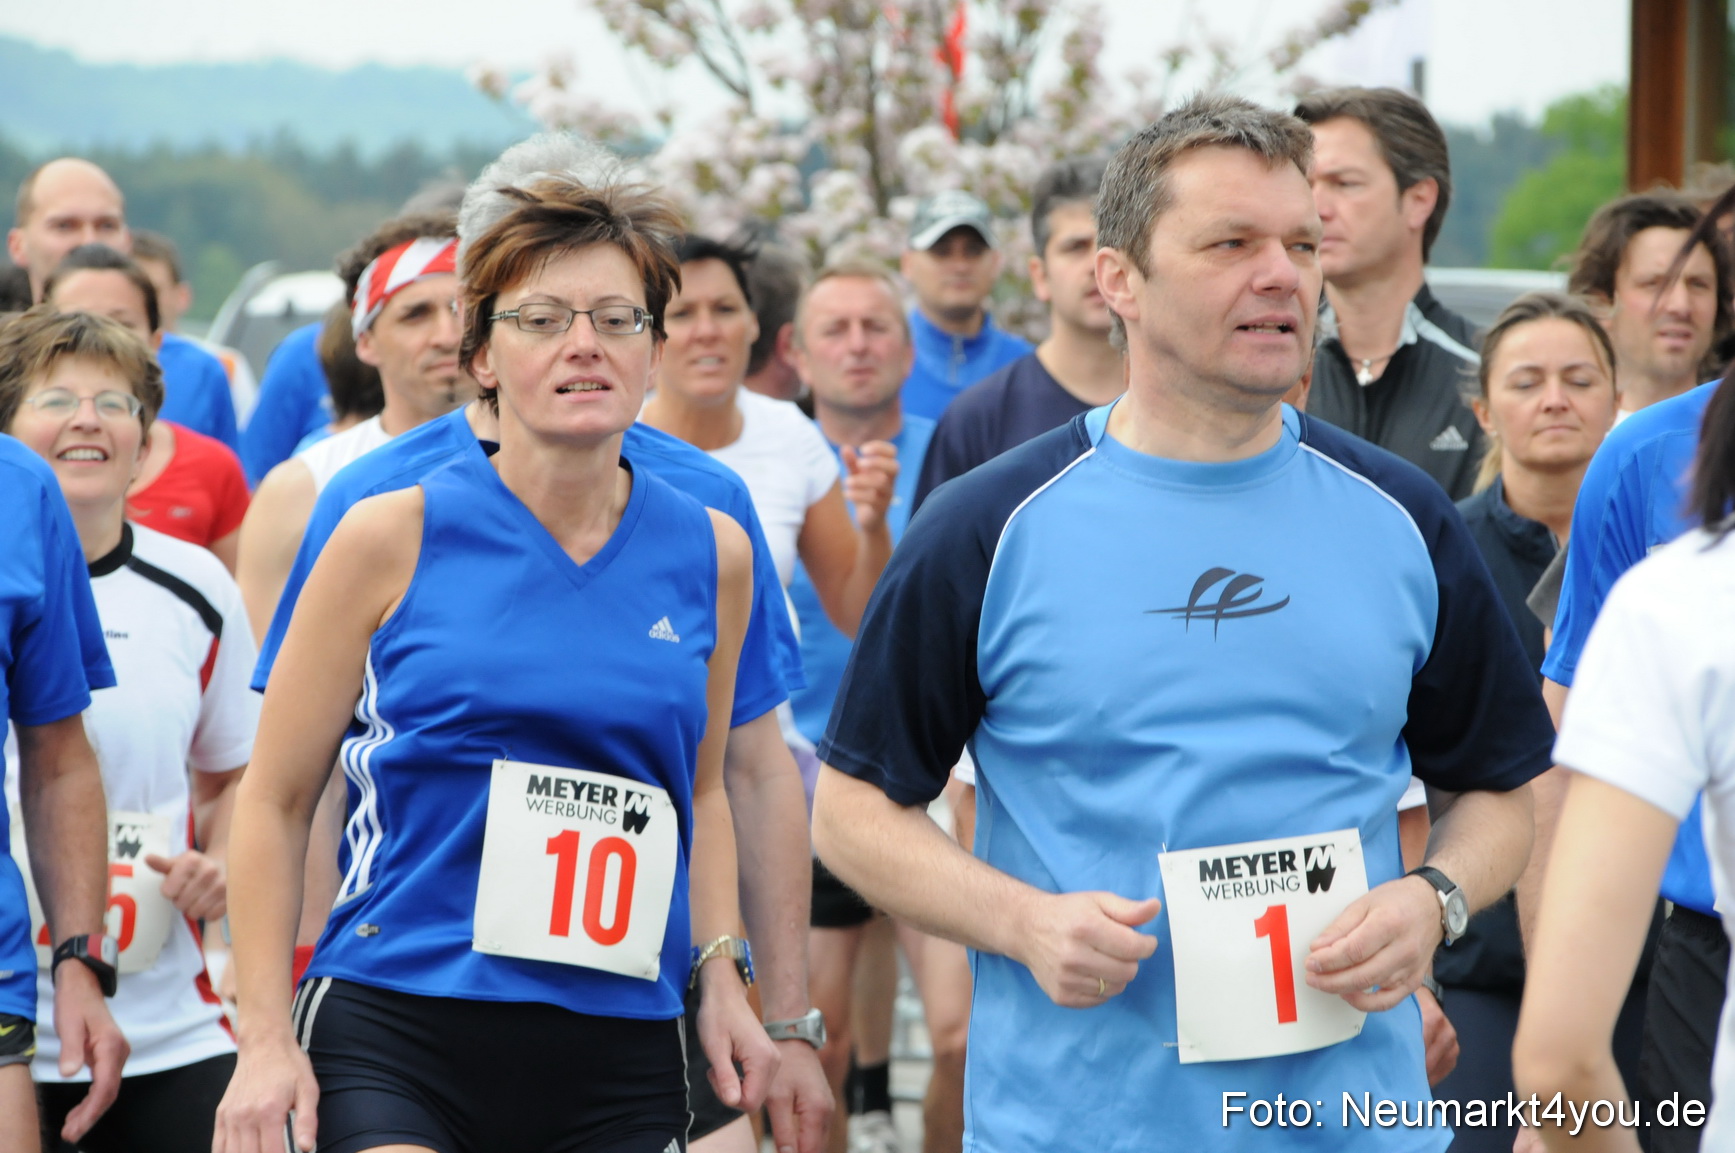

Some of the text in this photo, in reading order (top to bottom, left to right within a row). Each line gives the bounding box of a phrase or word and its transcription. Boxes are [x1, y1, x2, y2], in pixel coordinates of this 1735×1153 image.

[649, 629, 680, 643] adidas
[526, 774, 618, 807] MEYER
[526, 797, 617, 825] WERBUNG
[1199, 850, 1298, 882] MEYER
[546, 829, 637, 946] 10
[1201, 875, 1301, 900] WERBUNG
[37, 864, 136, 955] 5
[1254, 904, 1298, 1024] 1
